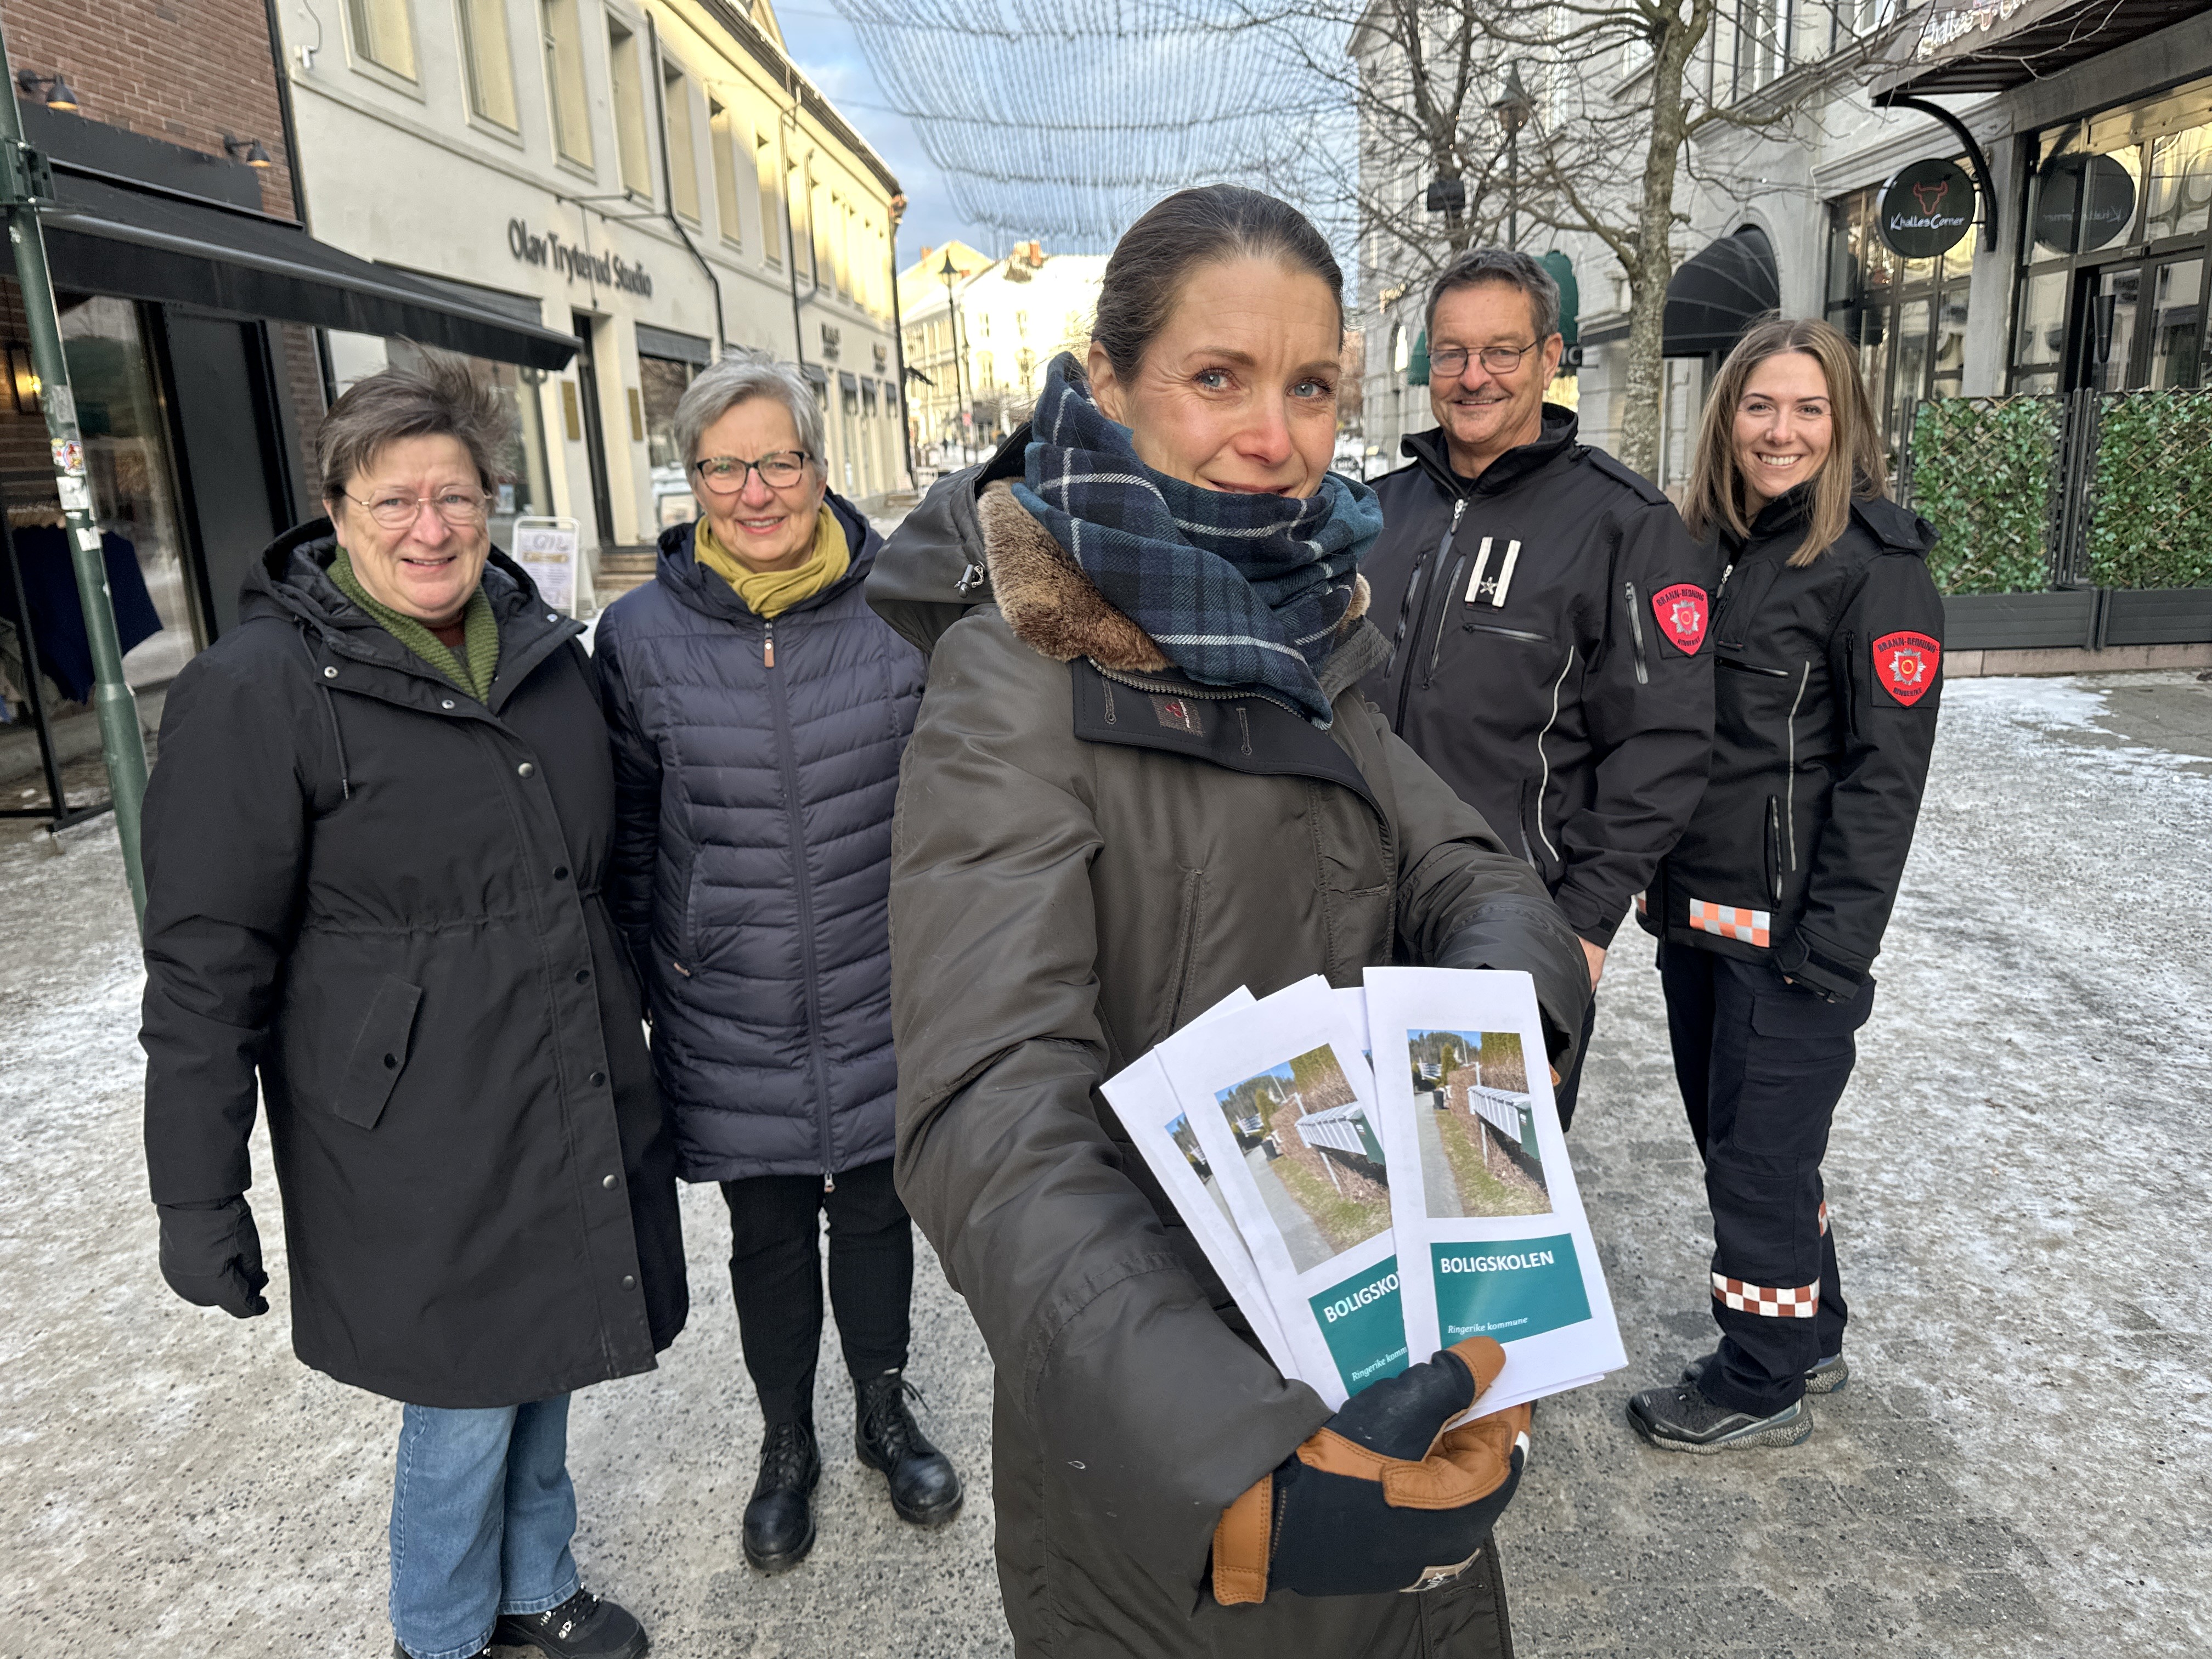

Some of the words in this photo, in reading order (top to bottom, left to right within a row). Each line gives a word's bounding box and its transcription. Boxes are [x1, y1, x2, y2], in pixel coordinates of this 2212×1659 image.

[507, 217, 546, 267] Olav
[612, 253, 652, 298] Studio
[1441, 1250, 1554, 1273] BOLIGSKOLEN
[1323, 1271, 1399, 1323] BOLIGSKO
[1448, 1323, 1486, 1335] Ringerike
[1487, 1317, 1528, 1331] kommune
[1351, 1358, 1386, 1381] Ringerike
